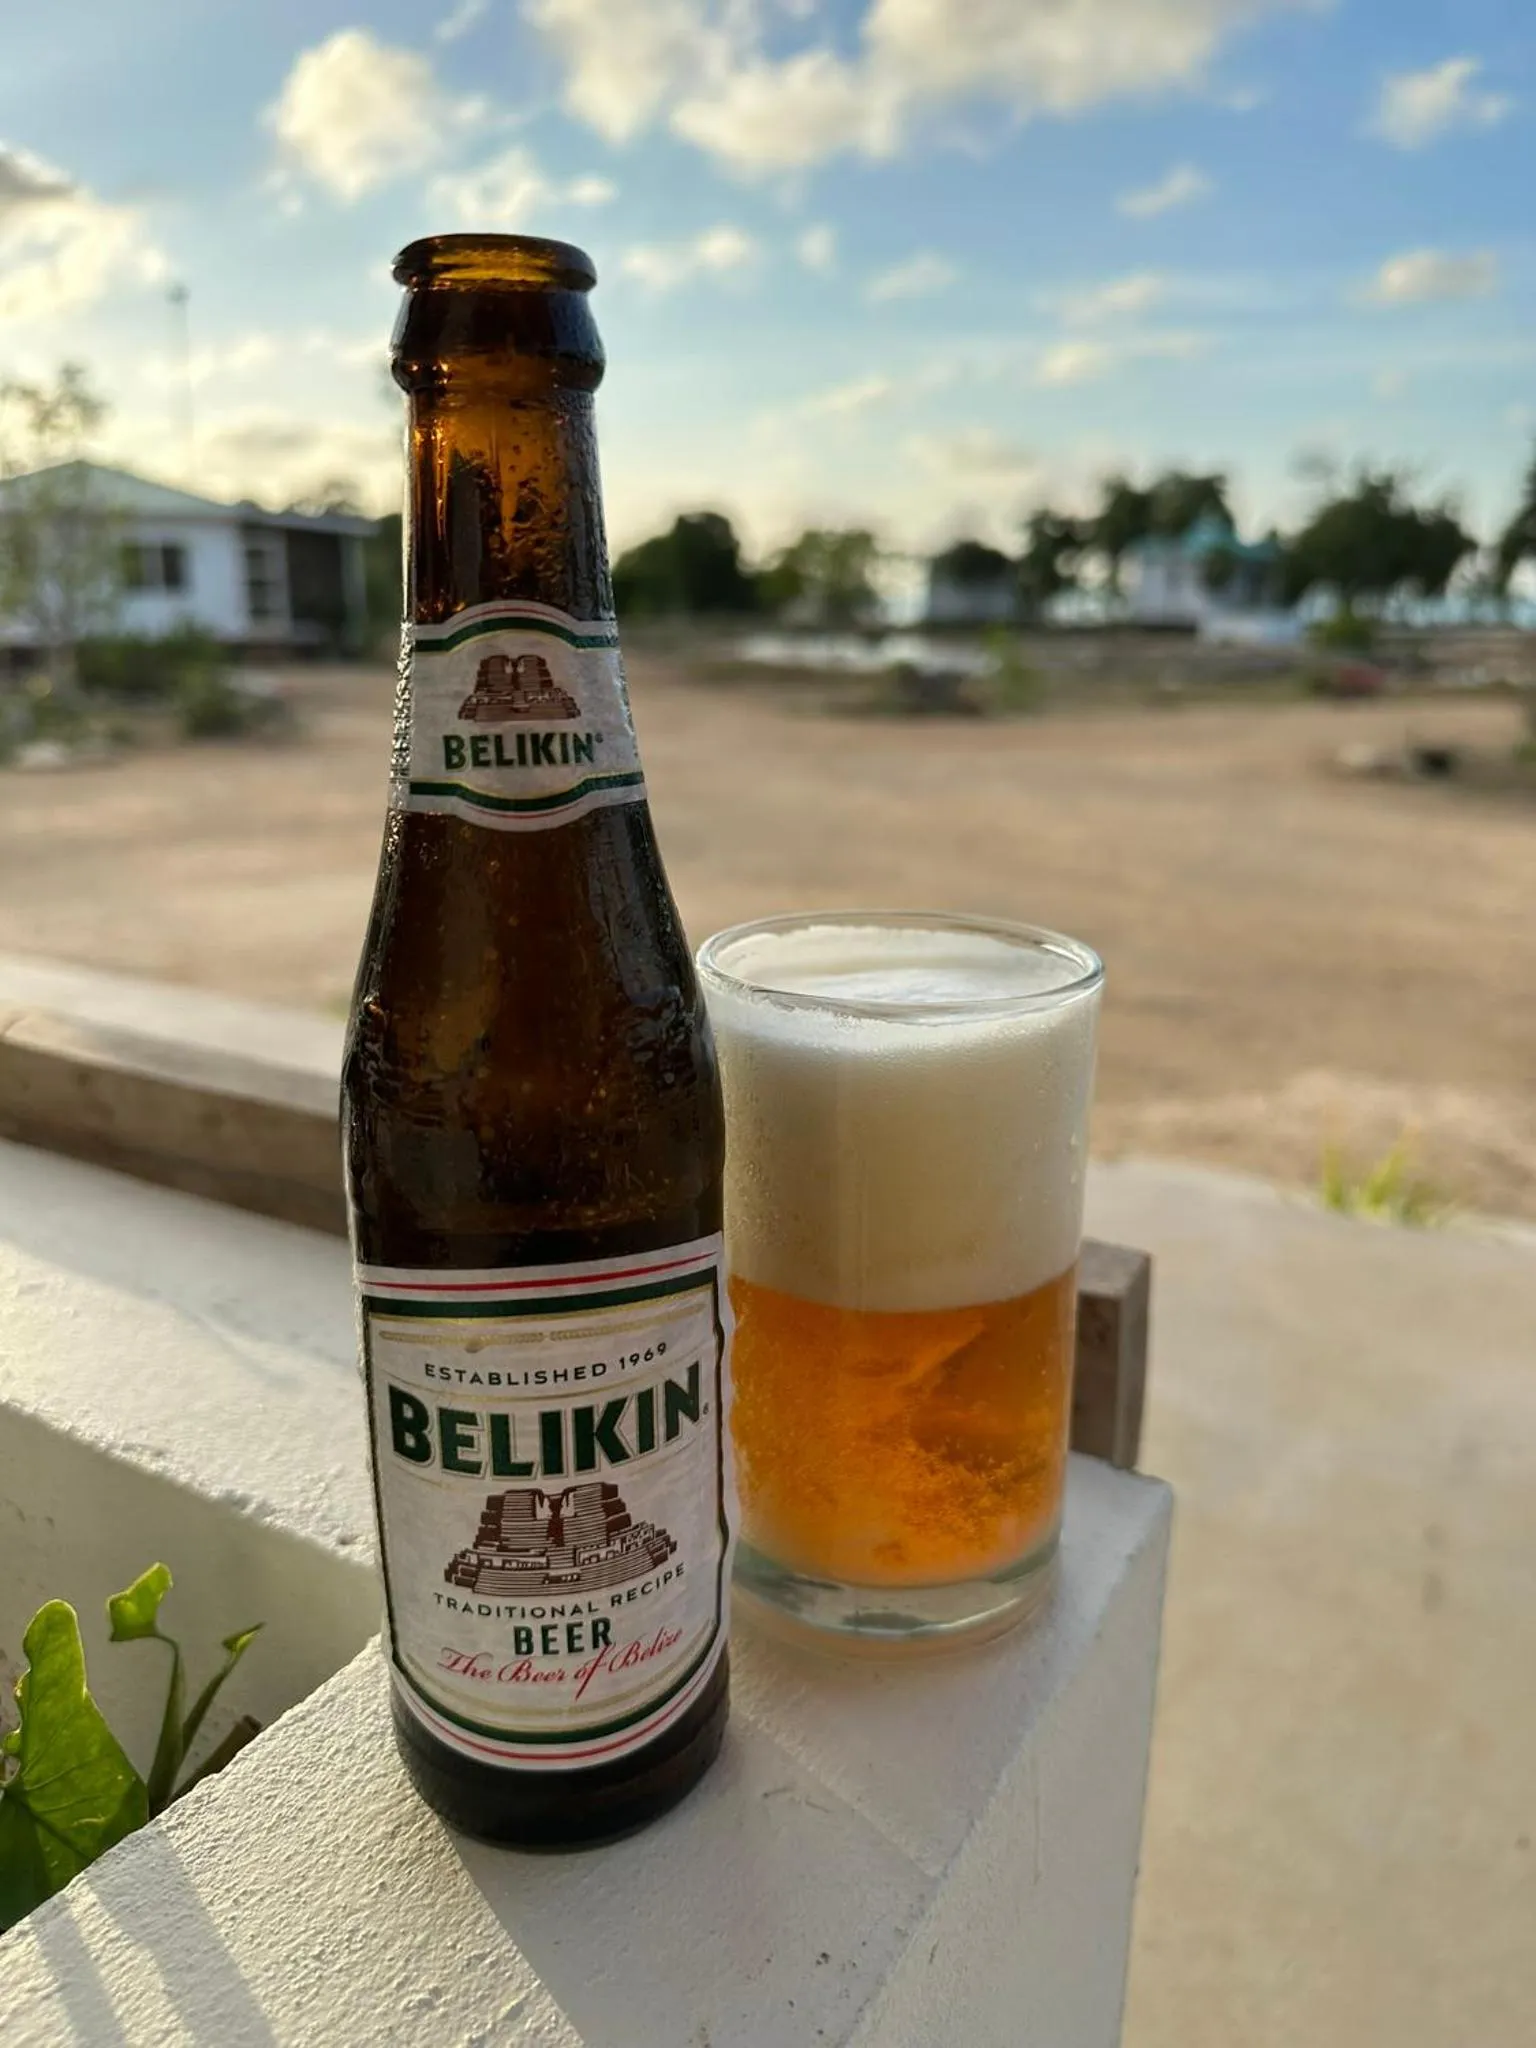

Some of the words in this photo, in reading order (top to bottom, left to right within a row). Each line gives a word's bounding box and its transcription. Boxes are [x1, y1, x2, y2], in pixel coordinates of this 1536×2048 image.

[442, 732, 594, 770] BELIKIN
[424, 1362, 606, 1386] ESTABLISHED
[618, 1341, 668, 1370] 1969
[388, 1360, 701, 1478] BELIKIN
[433, 1592, 599, 1619] TRADITIONAL
[610, 1562, 685, 1608] RECIPE
[513, 1617, 613, 1656] BEER
[437, 1646, 491, 1681] The
[497, 1659, 567, 1683] Beer
[574, 1644, 610, 1701] of
[608, 1626, 683, 1673] Belize
